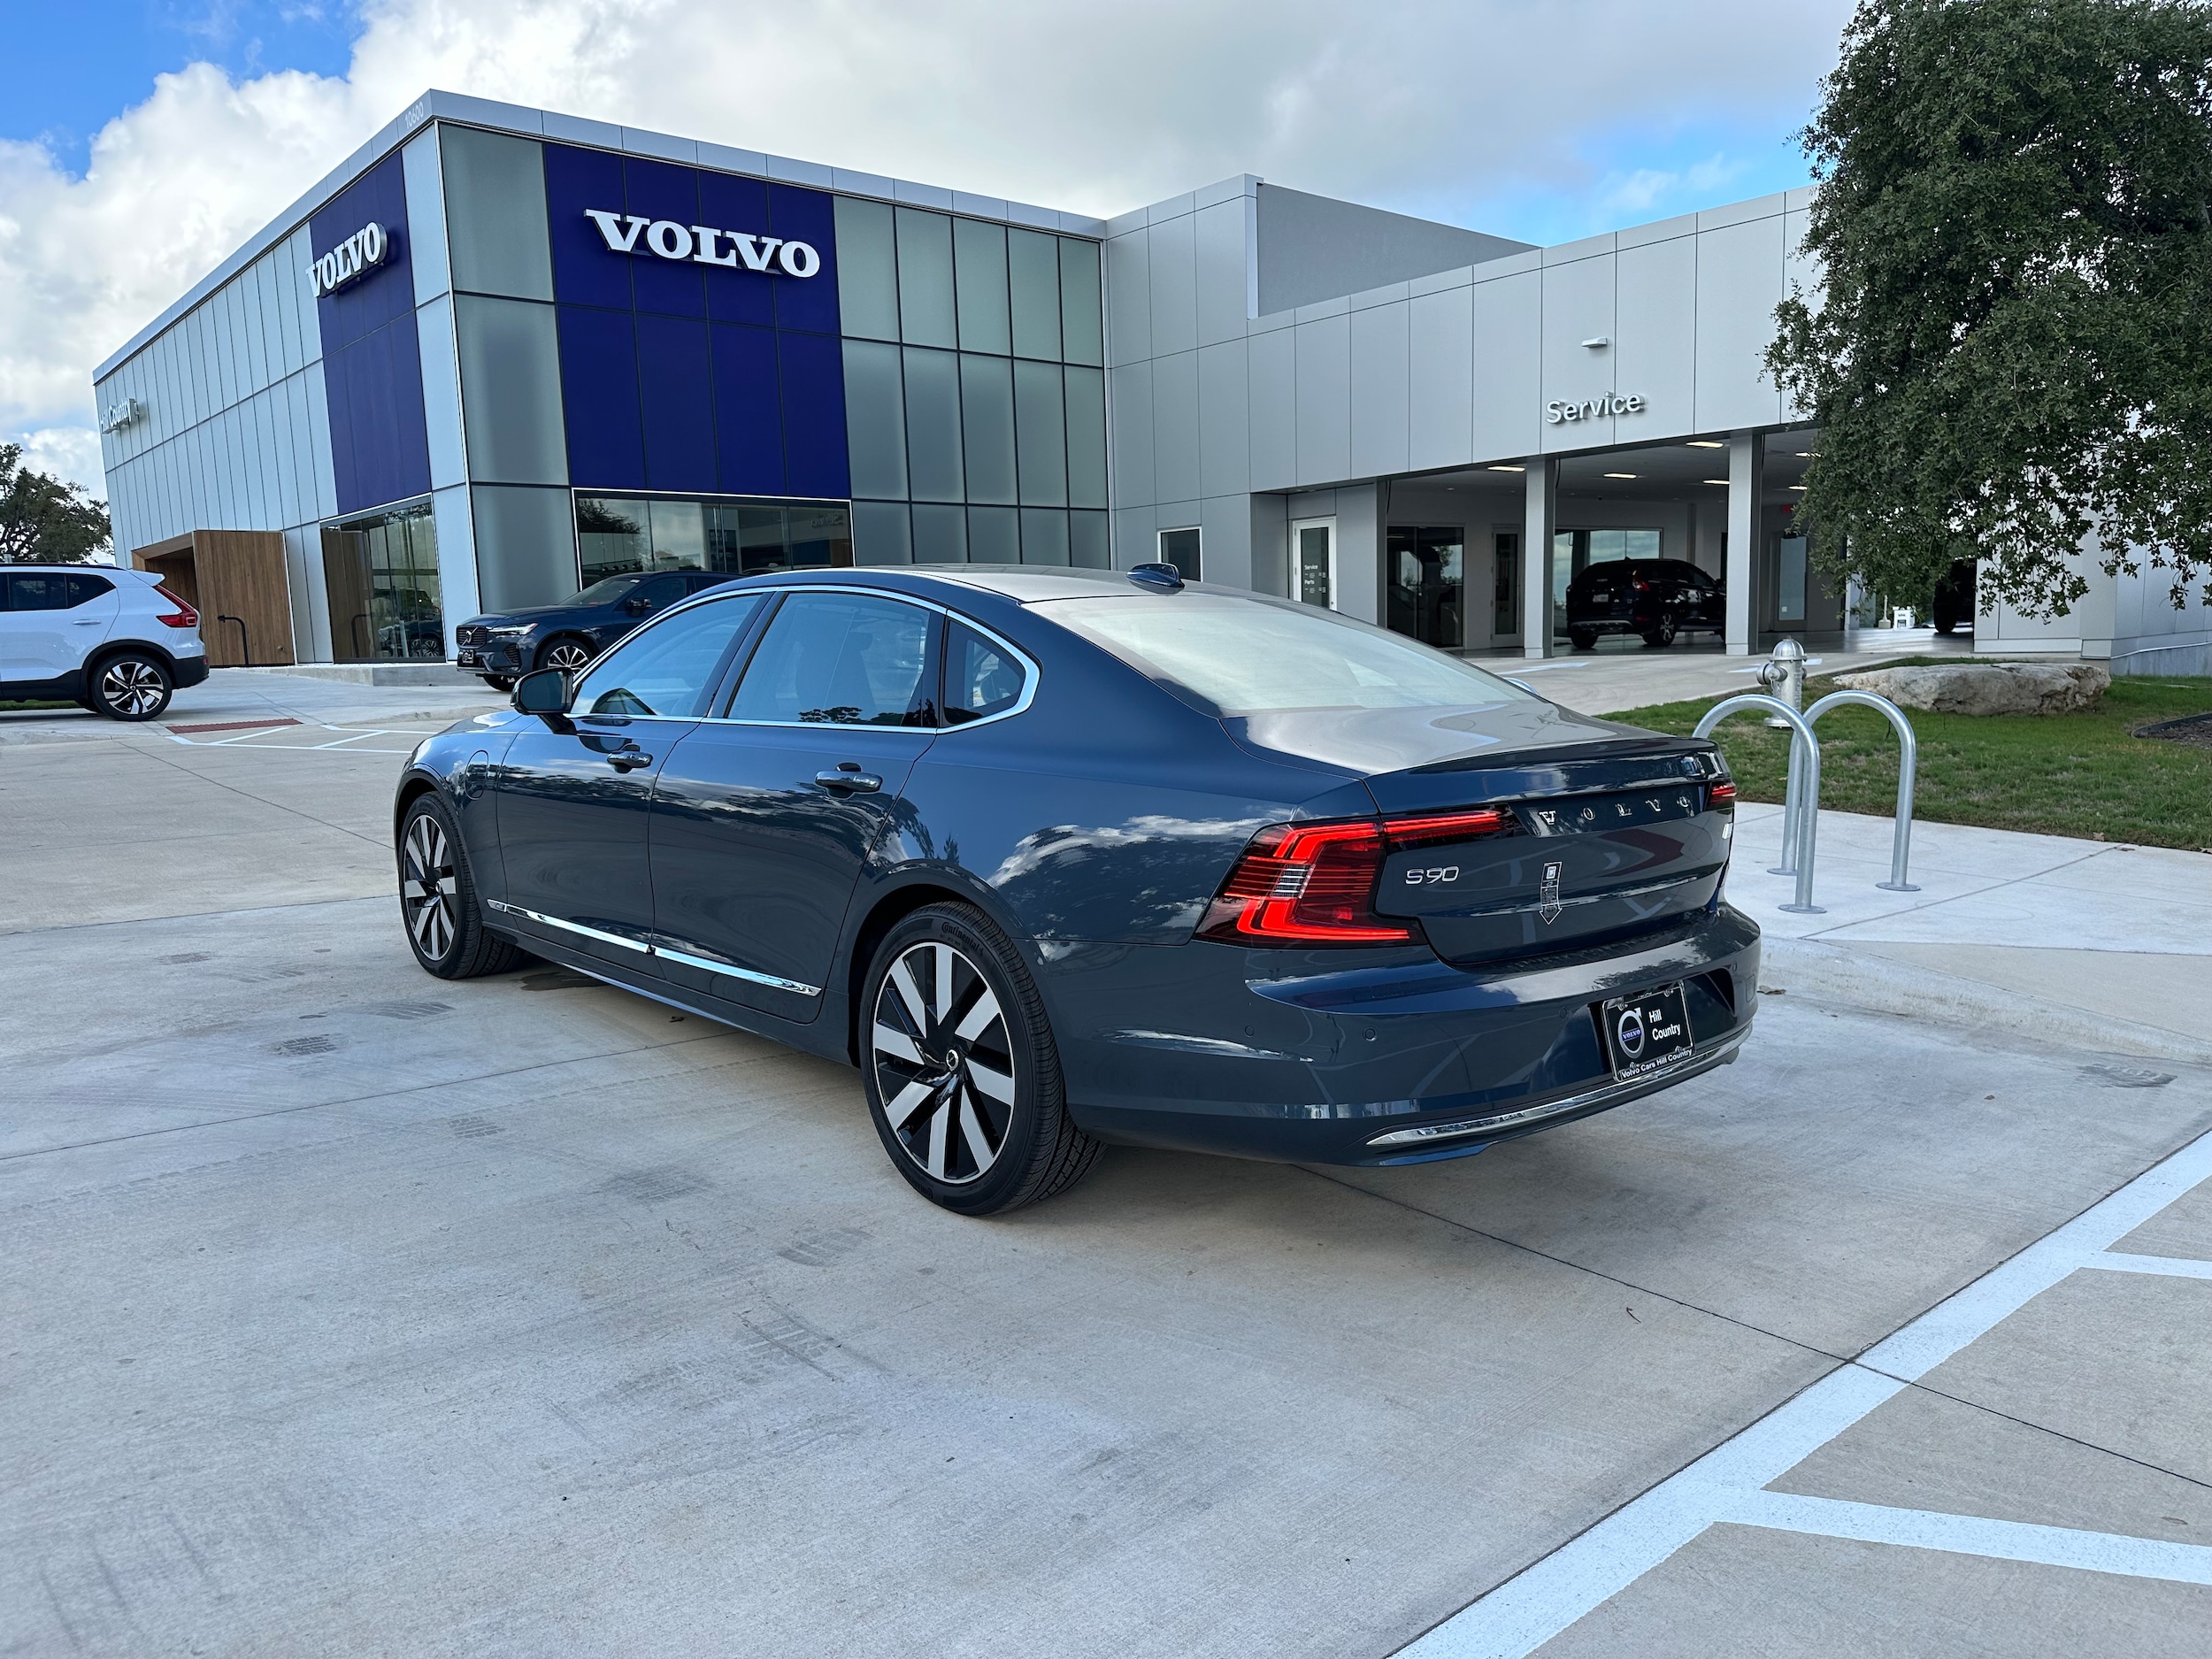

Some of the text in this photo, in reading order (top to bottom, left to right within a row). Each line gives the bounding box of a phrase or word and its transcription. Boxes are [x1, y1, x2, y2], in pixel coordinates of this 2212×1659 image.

[404, 101, 424, 129] 10600
[584, 208, 820, 278] VOLVO
[305, 221, 385, 298] VOLVO
[108, 398, 132, 427] Country
[1546, 391, 1641, 424] Service
[1539, 795, 1692, 826] VOLVO
[1405, 865, 1460, 885] S90
[941, 921, 980, 952] Continental
[1648, 1009, 1663, 1024] Hill
[1622, 1029, 1641, 1040] VOLVO
[1652, 1024, 1681, 1041] Country
[1622, 1048, 1693, 1078] Volvo Cars Hill Country
